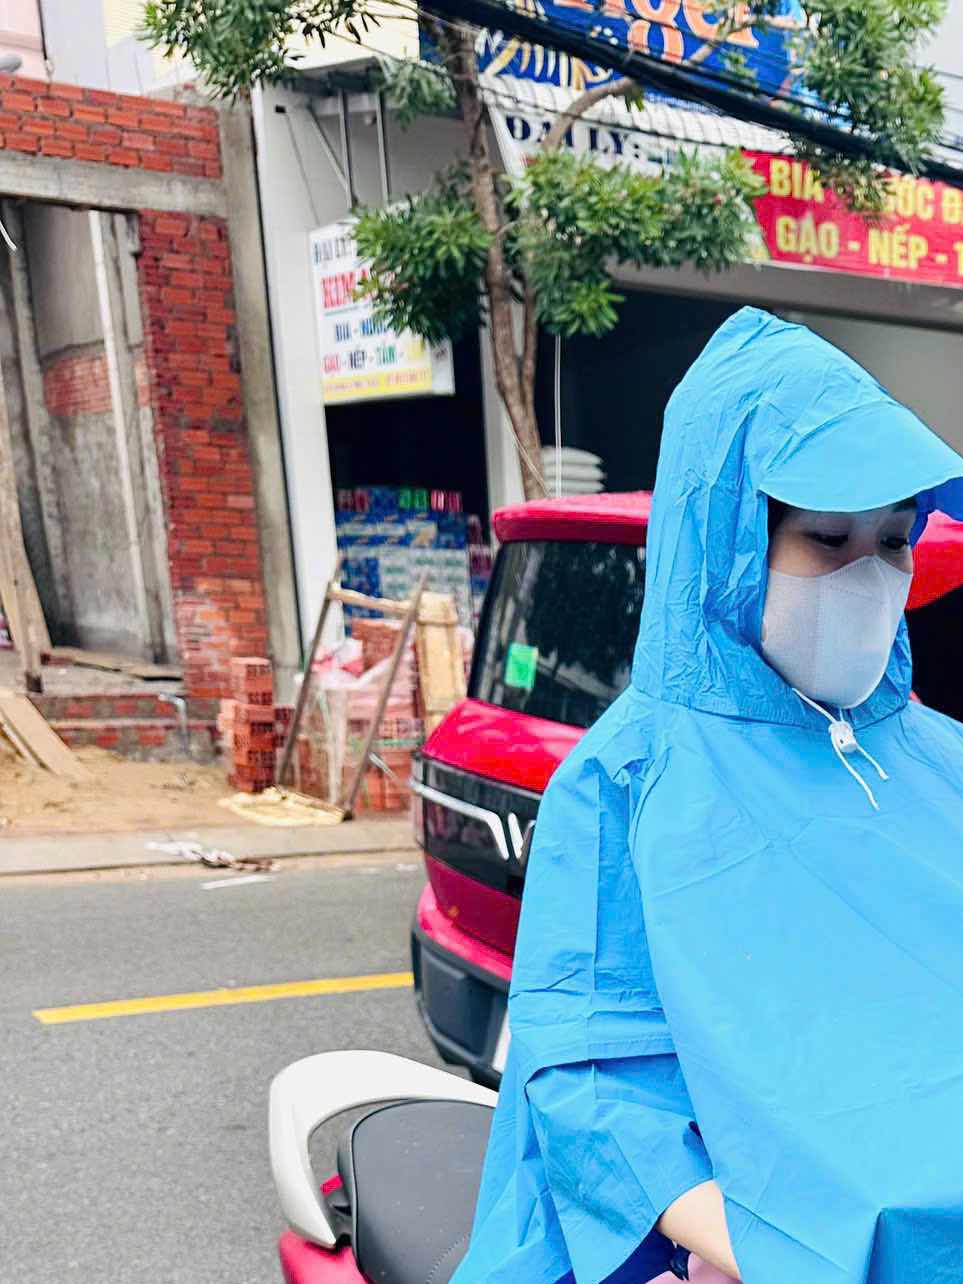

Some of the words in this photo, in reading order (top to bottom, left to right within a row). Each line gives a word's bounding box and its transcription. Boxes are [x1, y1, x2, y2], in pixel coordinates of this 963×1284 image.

[769, 159, 825, 203] BIA
[776, 211, 840, 264] GẠO
[867, 223, 929, 271] NẾP
